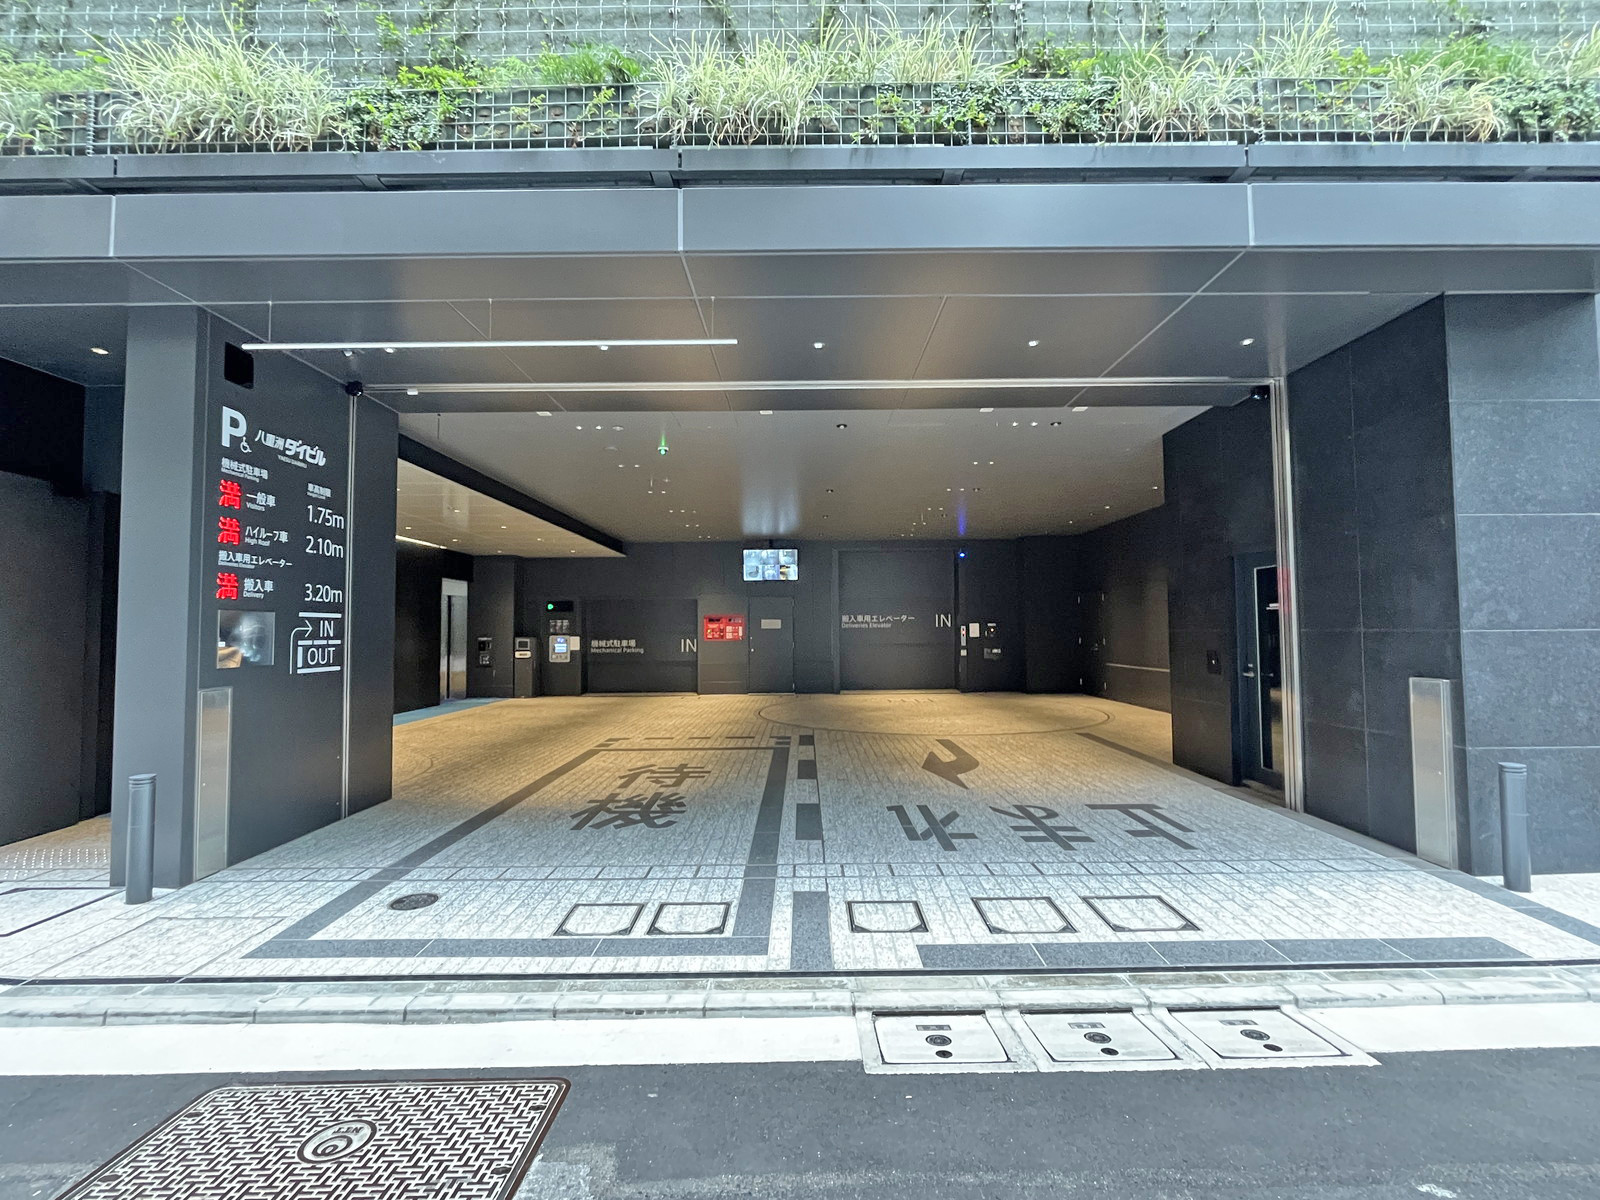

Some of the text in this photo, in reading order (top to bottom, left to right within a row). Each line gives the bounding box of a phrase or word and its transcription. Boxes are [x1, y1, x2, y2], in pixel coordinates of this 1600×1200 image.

[221, 405, 247, 448] P
[219, 479, 242, 509] 満
[246, 492, 276, 507] 一般車
[306, 504, 345, 529] 1.75m
[217, 516, 241, 546] 満
[245, 525, 289, 544] ハイルーフ車
[244, 537, 271, 547] High Roof
[305, 535, 344, 559] 2.10m
[218, 550, 293, 568] 搬入車用エレベーター
[215, 572, 239, 600] 満
[243, 577, 274, 593] 搬入車
[304, 583, 343, 604] 3.20m
[243, 591, 265, 600] Delivery
[320, 620, 334, 638] IN
[935, 613, 952, 628] IN
[680, 638, 697, 653] IN
[307, 647, 336, 665] OUT
[570, 762, 712, 832] 待機
[885, 803, 1198, 852] 止まれ
[331, 1126, 364, 1135] NTT
